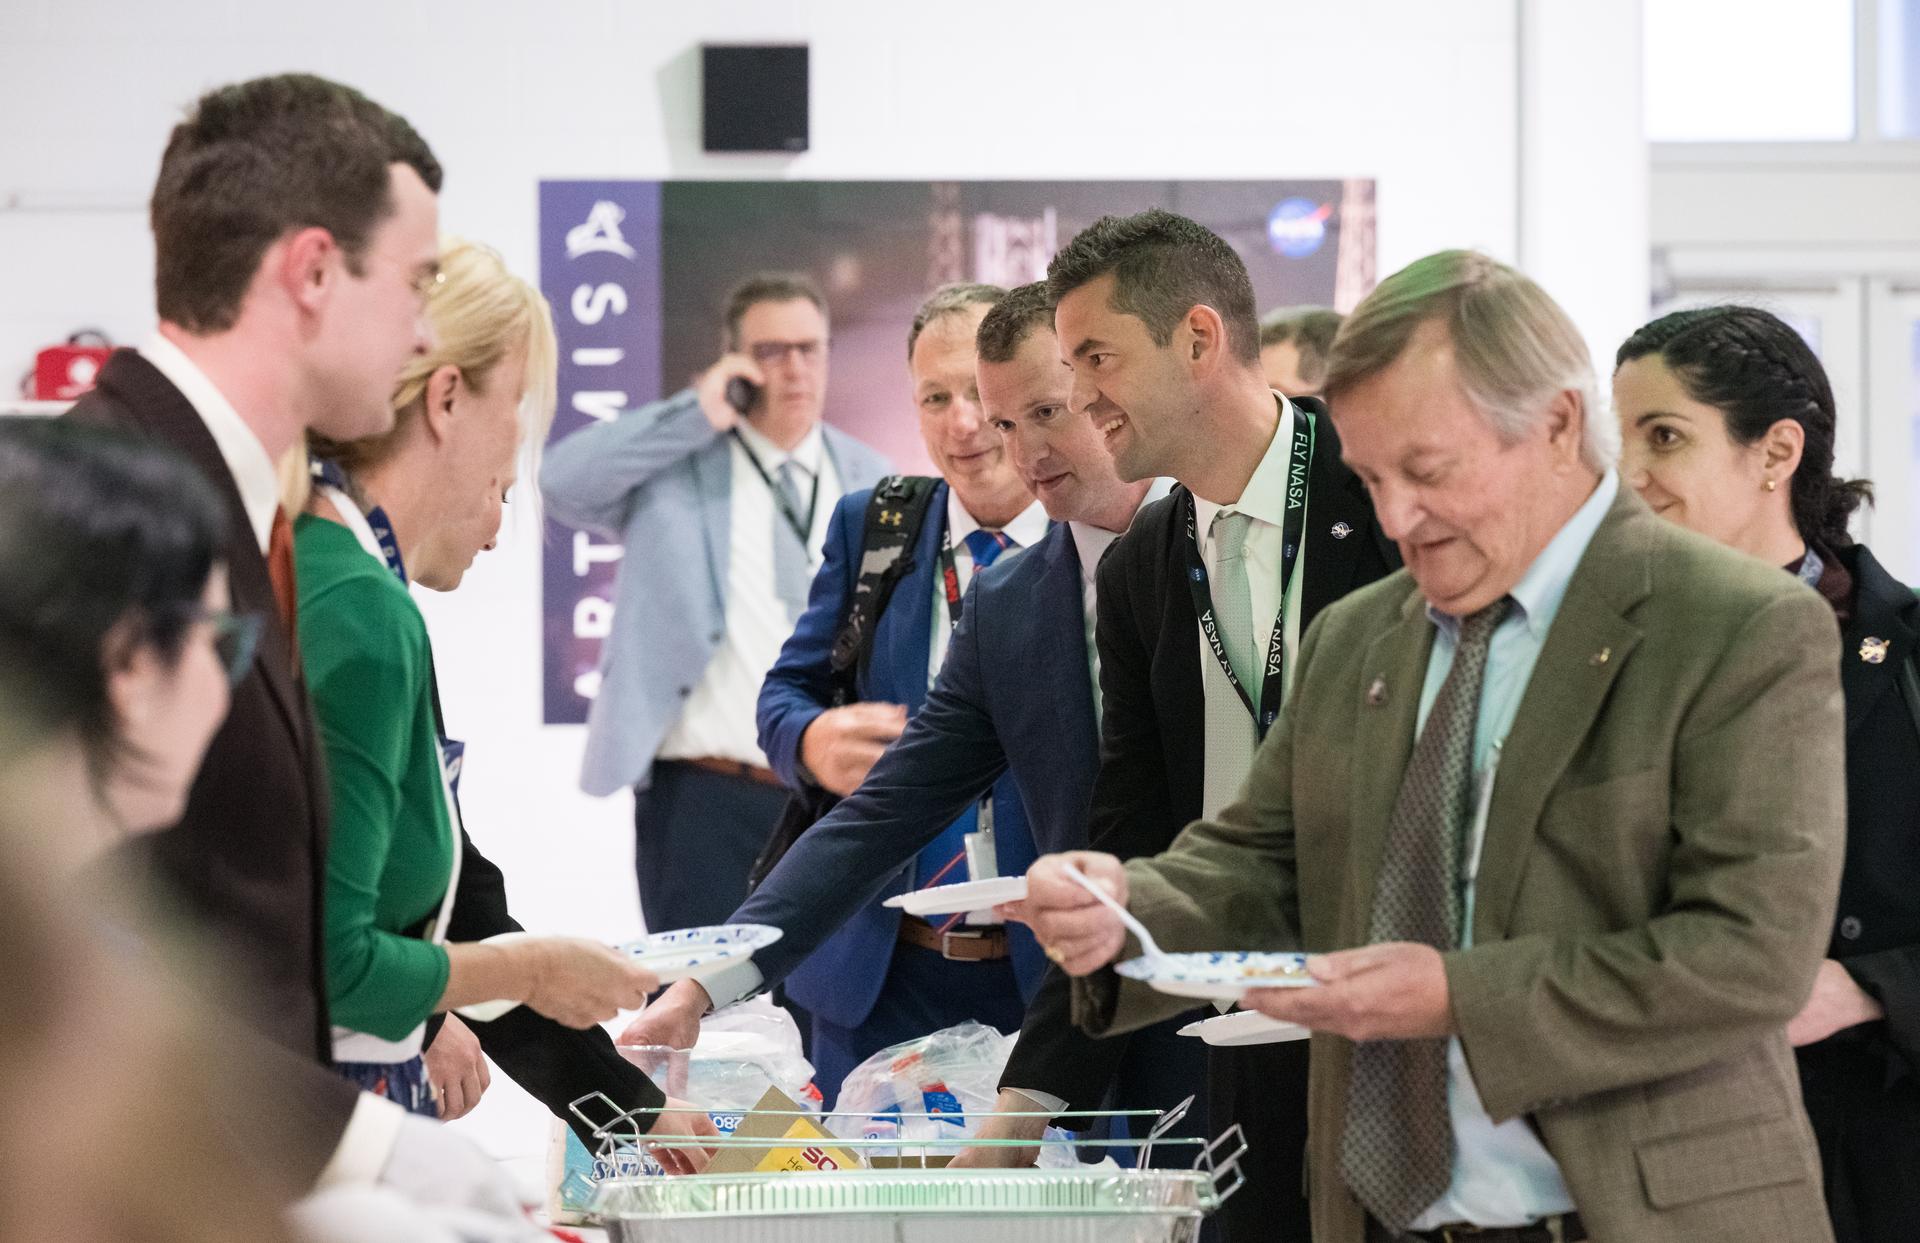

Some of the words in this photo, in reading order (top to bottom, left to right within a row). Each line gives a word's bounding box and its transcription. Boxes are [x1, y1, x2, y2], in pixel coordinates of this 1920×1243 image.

[1293, 431, 1308, 461] FLY
[572, 282, 629, 699] RTMIS
[1287, 463, 1306, 509] NASA
[1201, 609, 1224, 656] NASA
[1266, 628, 1281, 676] NASA
[1220, 660, 1238, 685] FLY
